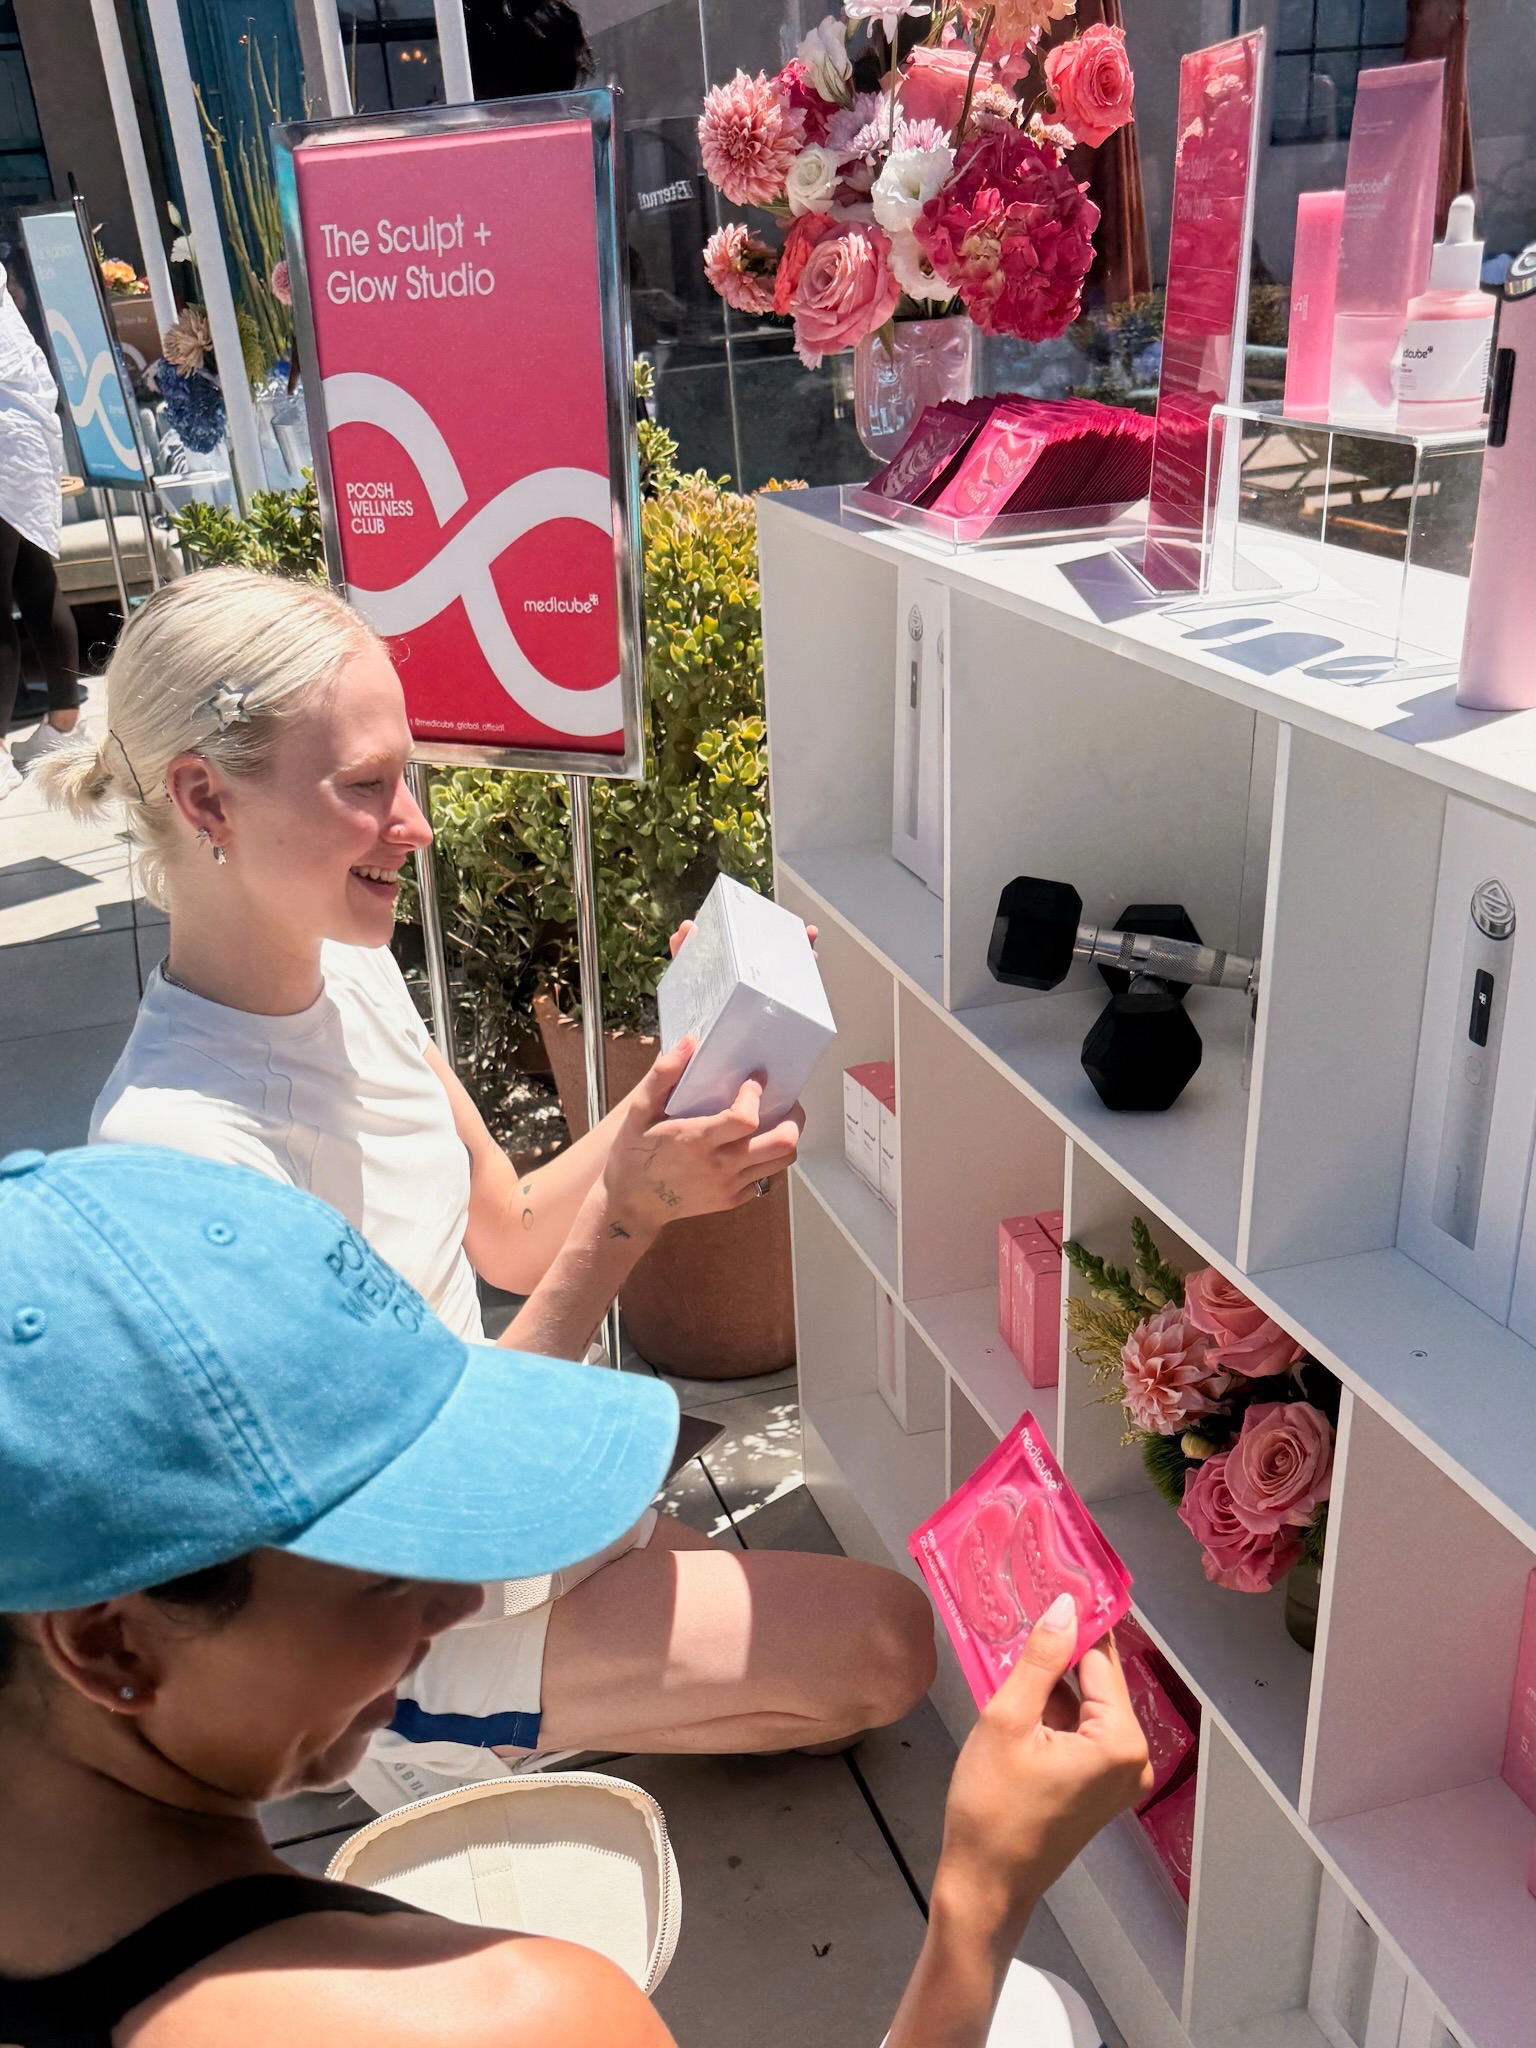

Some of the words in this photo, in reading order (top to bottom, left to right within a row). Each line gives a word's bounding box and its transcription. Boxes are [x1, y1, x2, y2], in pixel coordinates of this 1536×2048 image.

[320, 223, 370, 258] The
[377, 214, 464, 258] Sculpt
[474, 222, 491, 246] +
[327, 270, 398, 305] Glow
[406, 262, 495, 300] Studio
[346, 482, 394, 499] POOSH
[348, 499, 414, 517] WELLNESS
[351, 517, 386, 535] CLUB
[524, 596, 593, 614] medicube
[1020, 1427, 1057, 1491] medicube
